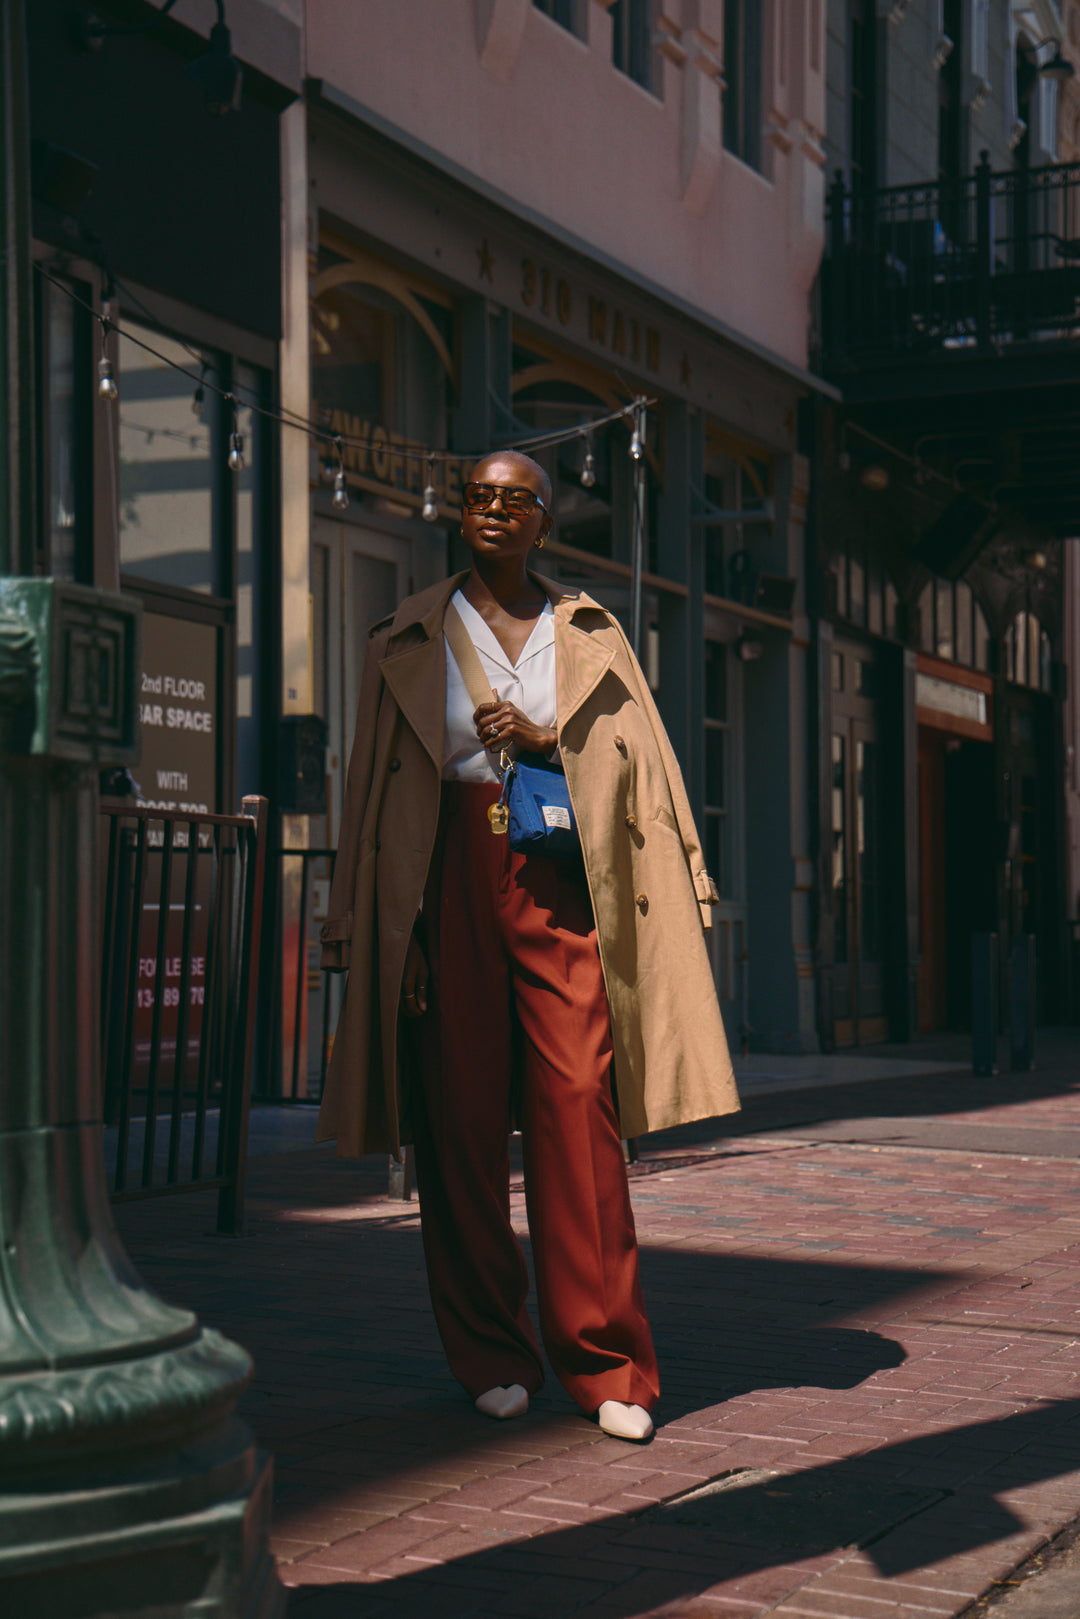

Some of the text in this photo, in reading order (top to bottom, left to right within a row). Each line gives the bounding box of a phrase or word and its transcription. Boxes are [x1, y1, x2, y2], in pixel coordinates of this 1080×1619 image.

[521, 258, 660, 374] 310 MAIN
[141, 672, 206, 700] 2nd FLOOR
[166, 707, 212, 733] SPACE
[156, 770, 189, 791] WITH
[138, 956, 205, 977] FO LESE
